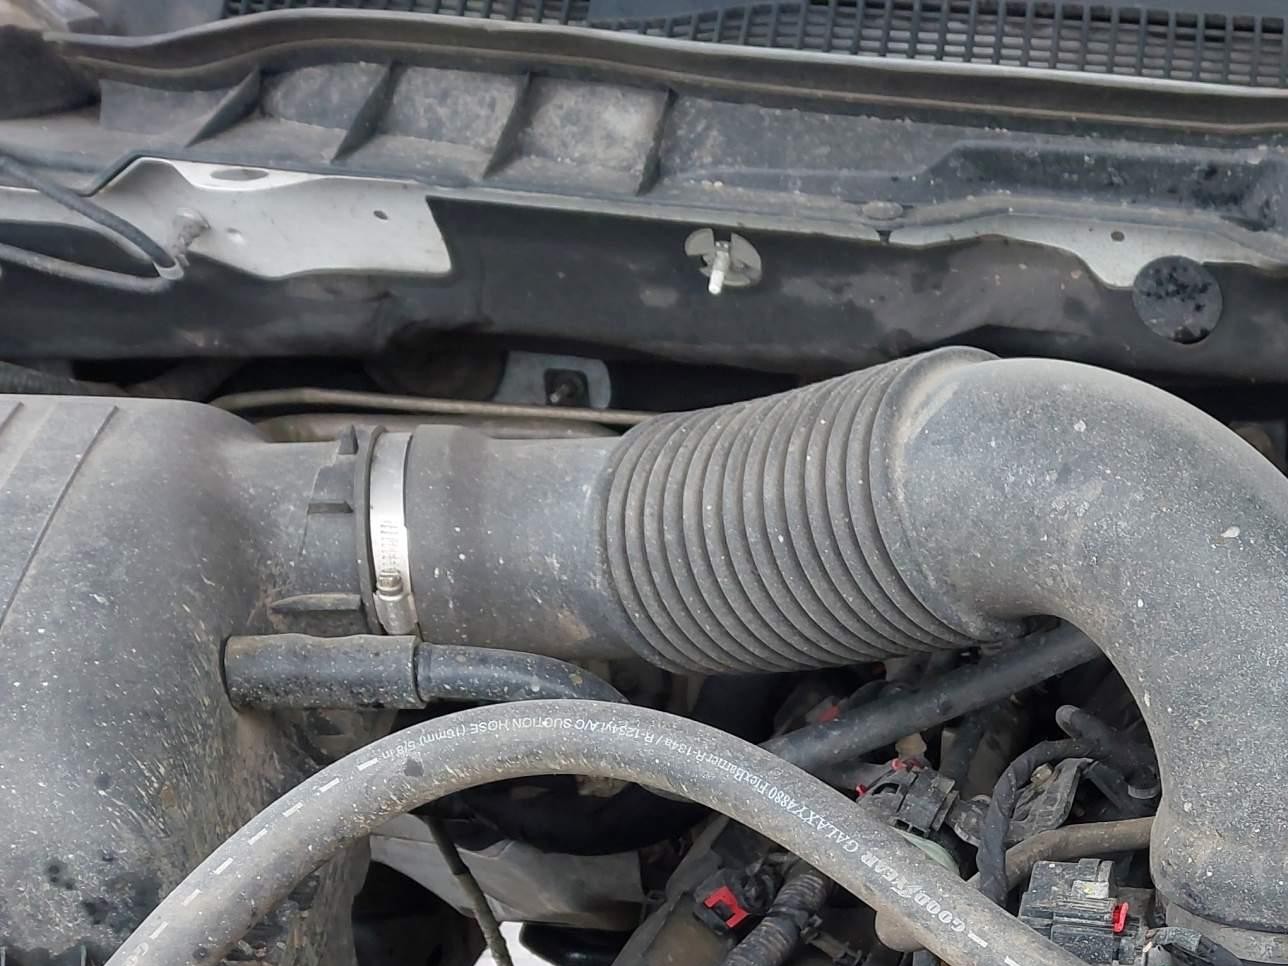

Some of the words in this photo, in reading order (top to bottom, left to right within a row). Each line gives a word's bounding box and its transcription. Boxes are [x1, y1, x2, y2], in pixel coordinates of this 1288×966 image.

[470, 719, 509, 735] HOSE
[512, 716, 571, 729] SUCTION
[419, 724, 466, 747] (16mm)
[860, 851, 966, 932] GOODYEAR
